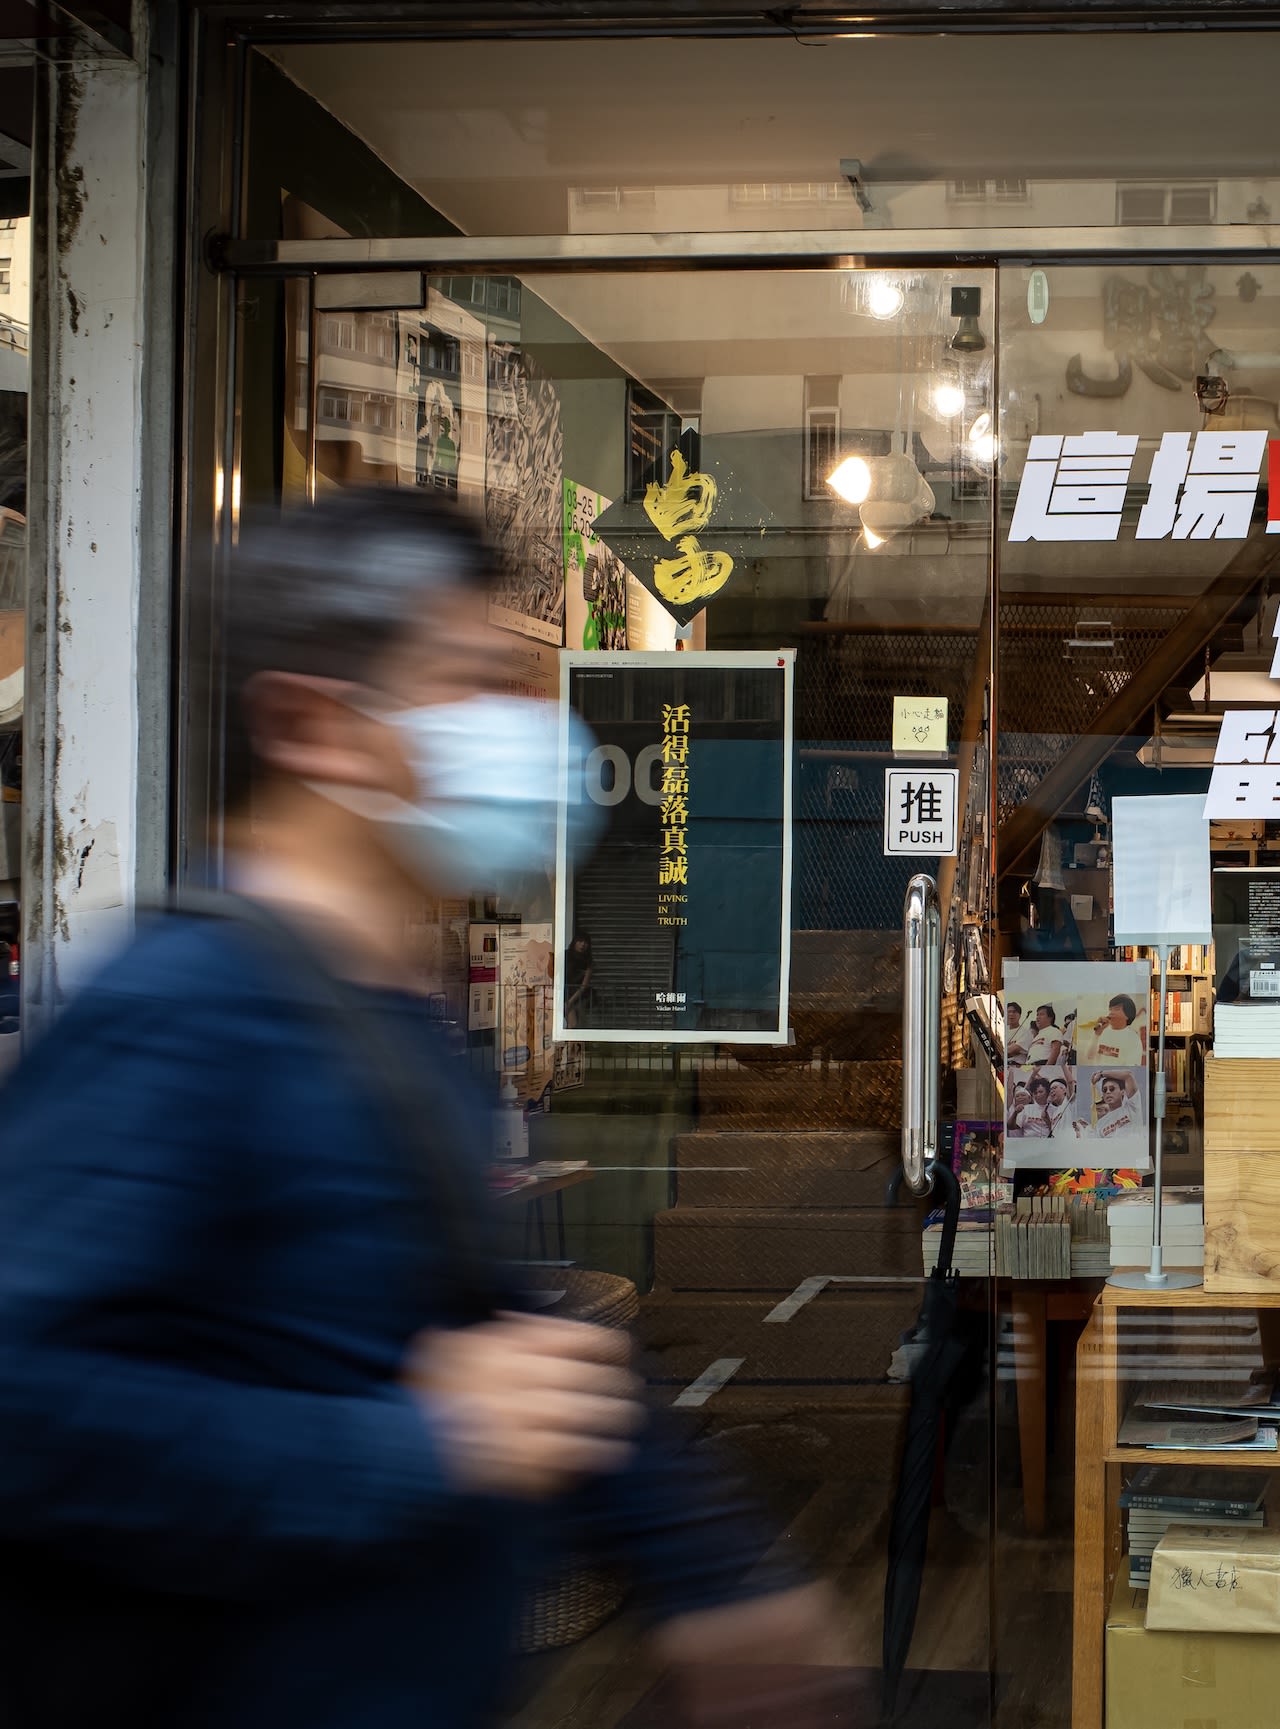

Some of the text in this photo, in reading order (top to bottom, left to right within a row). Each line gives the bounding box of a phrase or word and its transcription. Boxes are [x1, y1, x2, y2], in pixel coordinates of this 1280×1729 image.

[658, 703, 691, 885] 活得磊落真誠
[900, 781, 943, 824] 推
[899, 830, 943, 844] PUSH
[658, 894, 688, 903] LIVING
[658, 905, 668, 914] IN
[657, 917, 688, 926] TRUTH
